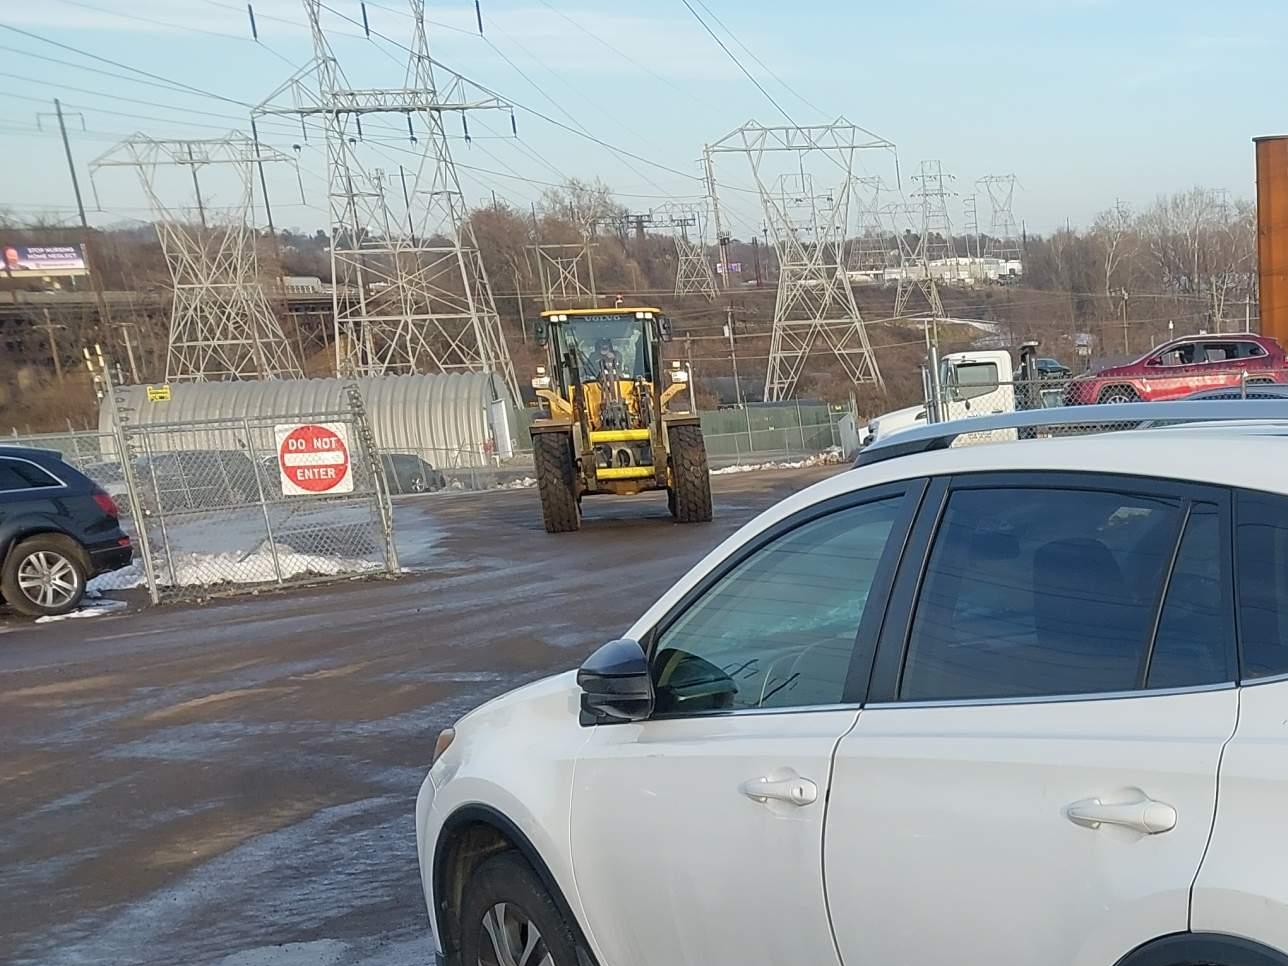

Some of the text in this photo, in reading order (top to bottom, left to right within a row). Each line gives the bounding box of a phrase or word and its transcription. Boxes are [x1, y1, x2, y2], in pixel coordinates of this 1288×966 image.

[288, 437, 338, 451] DO NOT
[296, 467, 336, 481] ENTER
